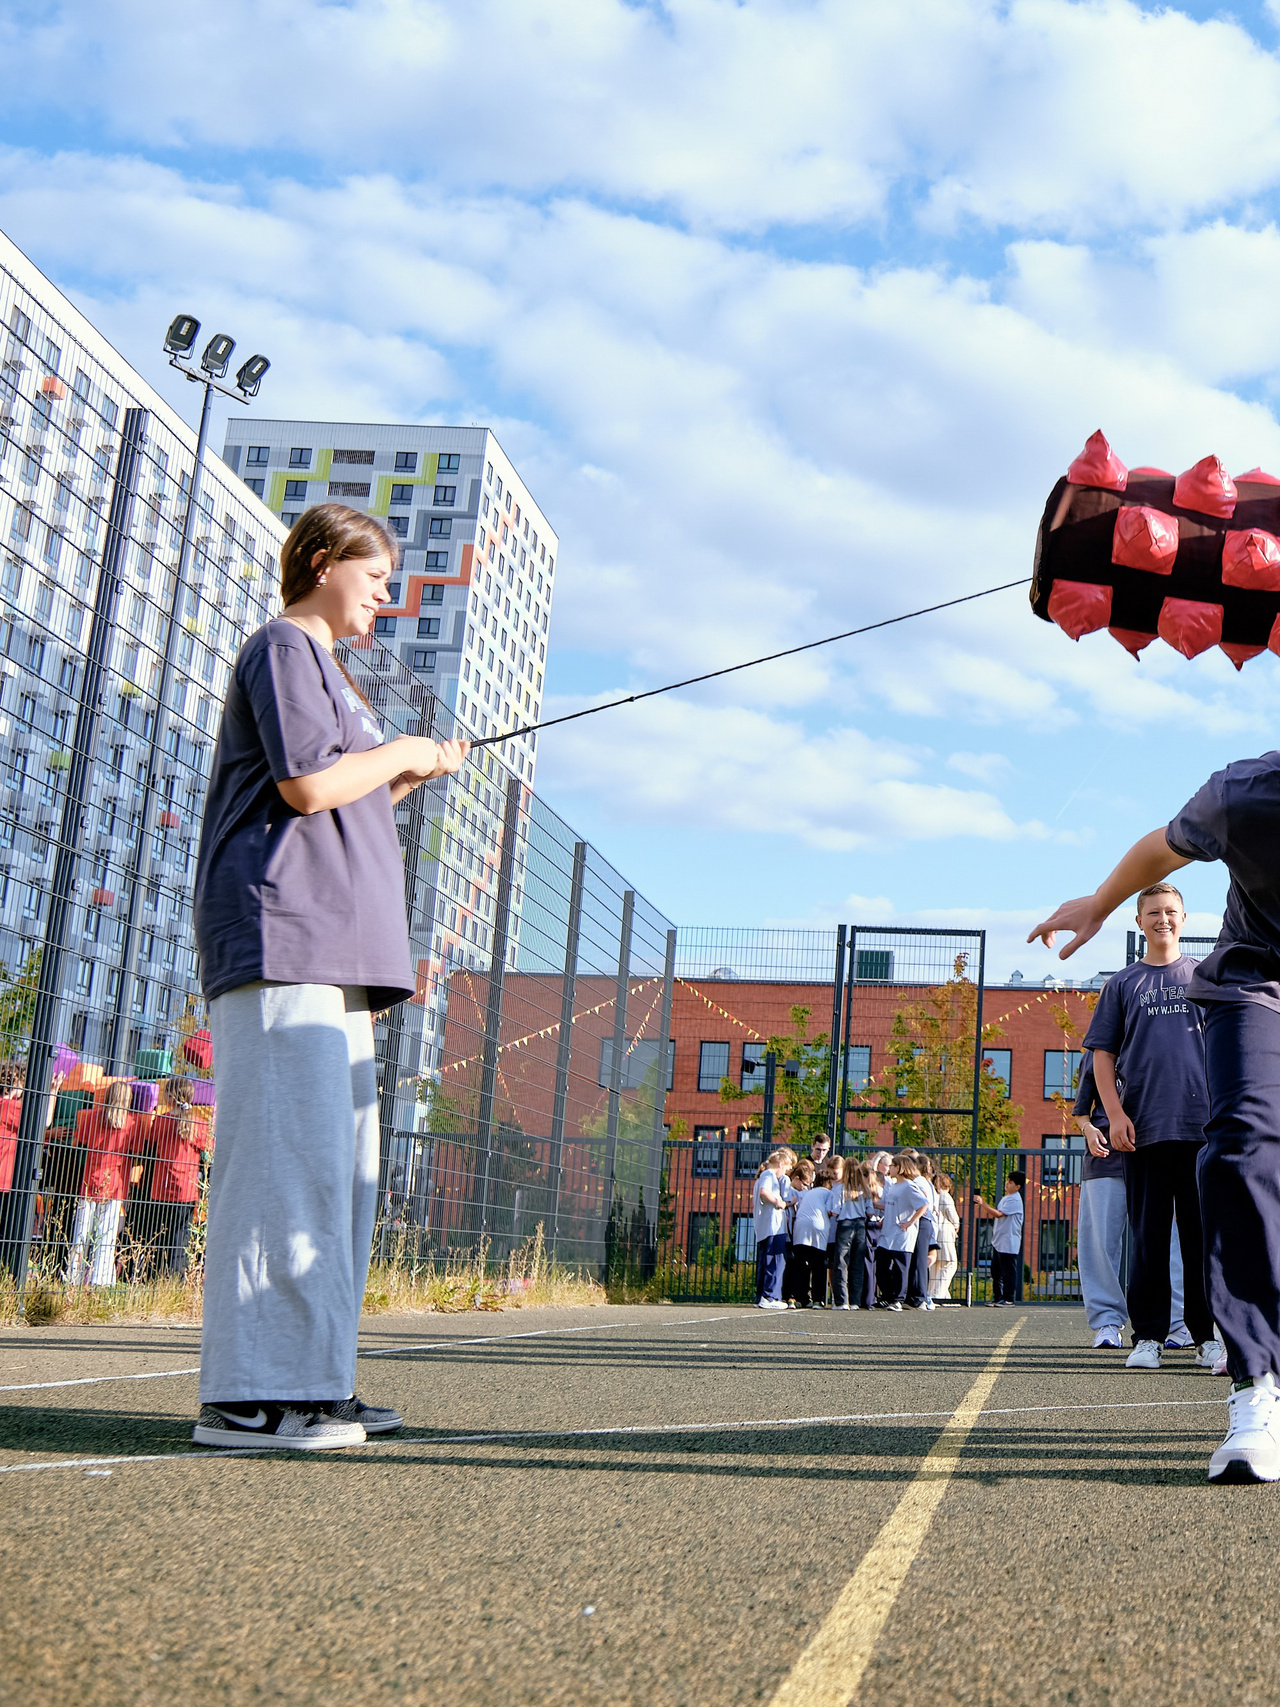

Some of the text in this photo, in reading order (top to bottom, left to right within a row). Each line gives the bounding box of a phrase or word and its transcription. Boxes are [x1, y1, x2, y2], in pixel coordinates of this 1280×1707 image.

[1139, 985, 1187, 1007] MY TEA
[1147, 1003, 1190, 1016] MY W.I.D.E.
